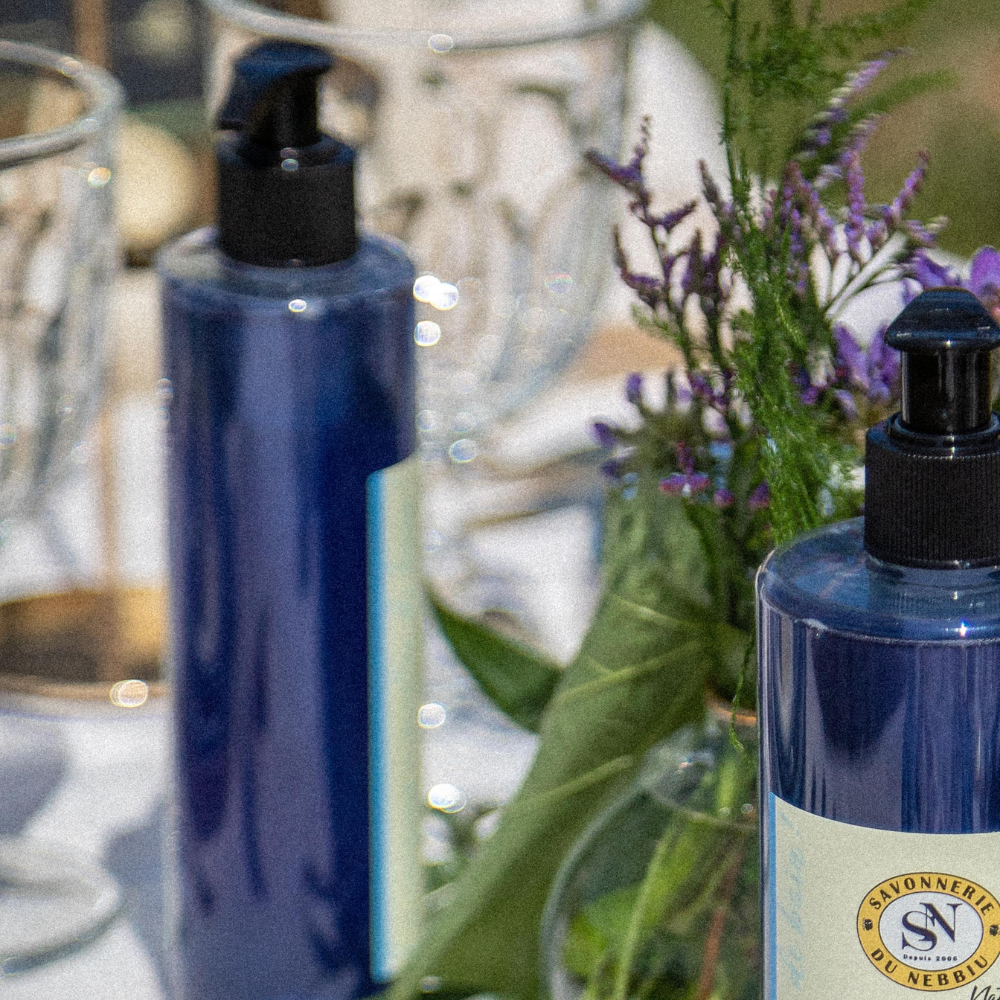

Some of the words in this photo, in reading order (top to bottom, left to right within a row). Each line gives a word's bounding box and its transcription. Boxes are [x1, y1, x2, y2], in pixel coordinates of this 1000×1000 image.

[869, 876, 994, 917] SAVONNERIE
[870, 948, 898, 974] DU
[907, 955, 988, 987] NEBBIU
[903, 953, 932, 962] Depuis
